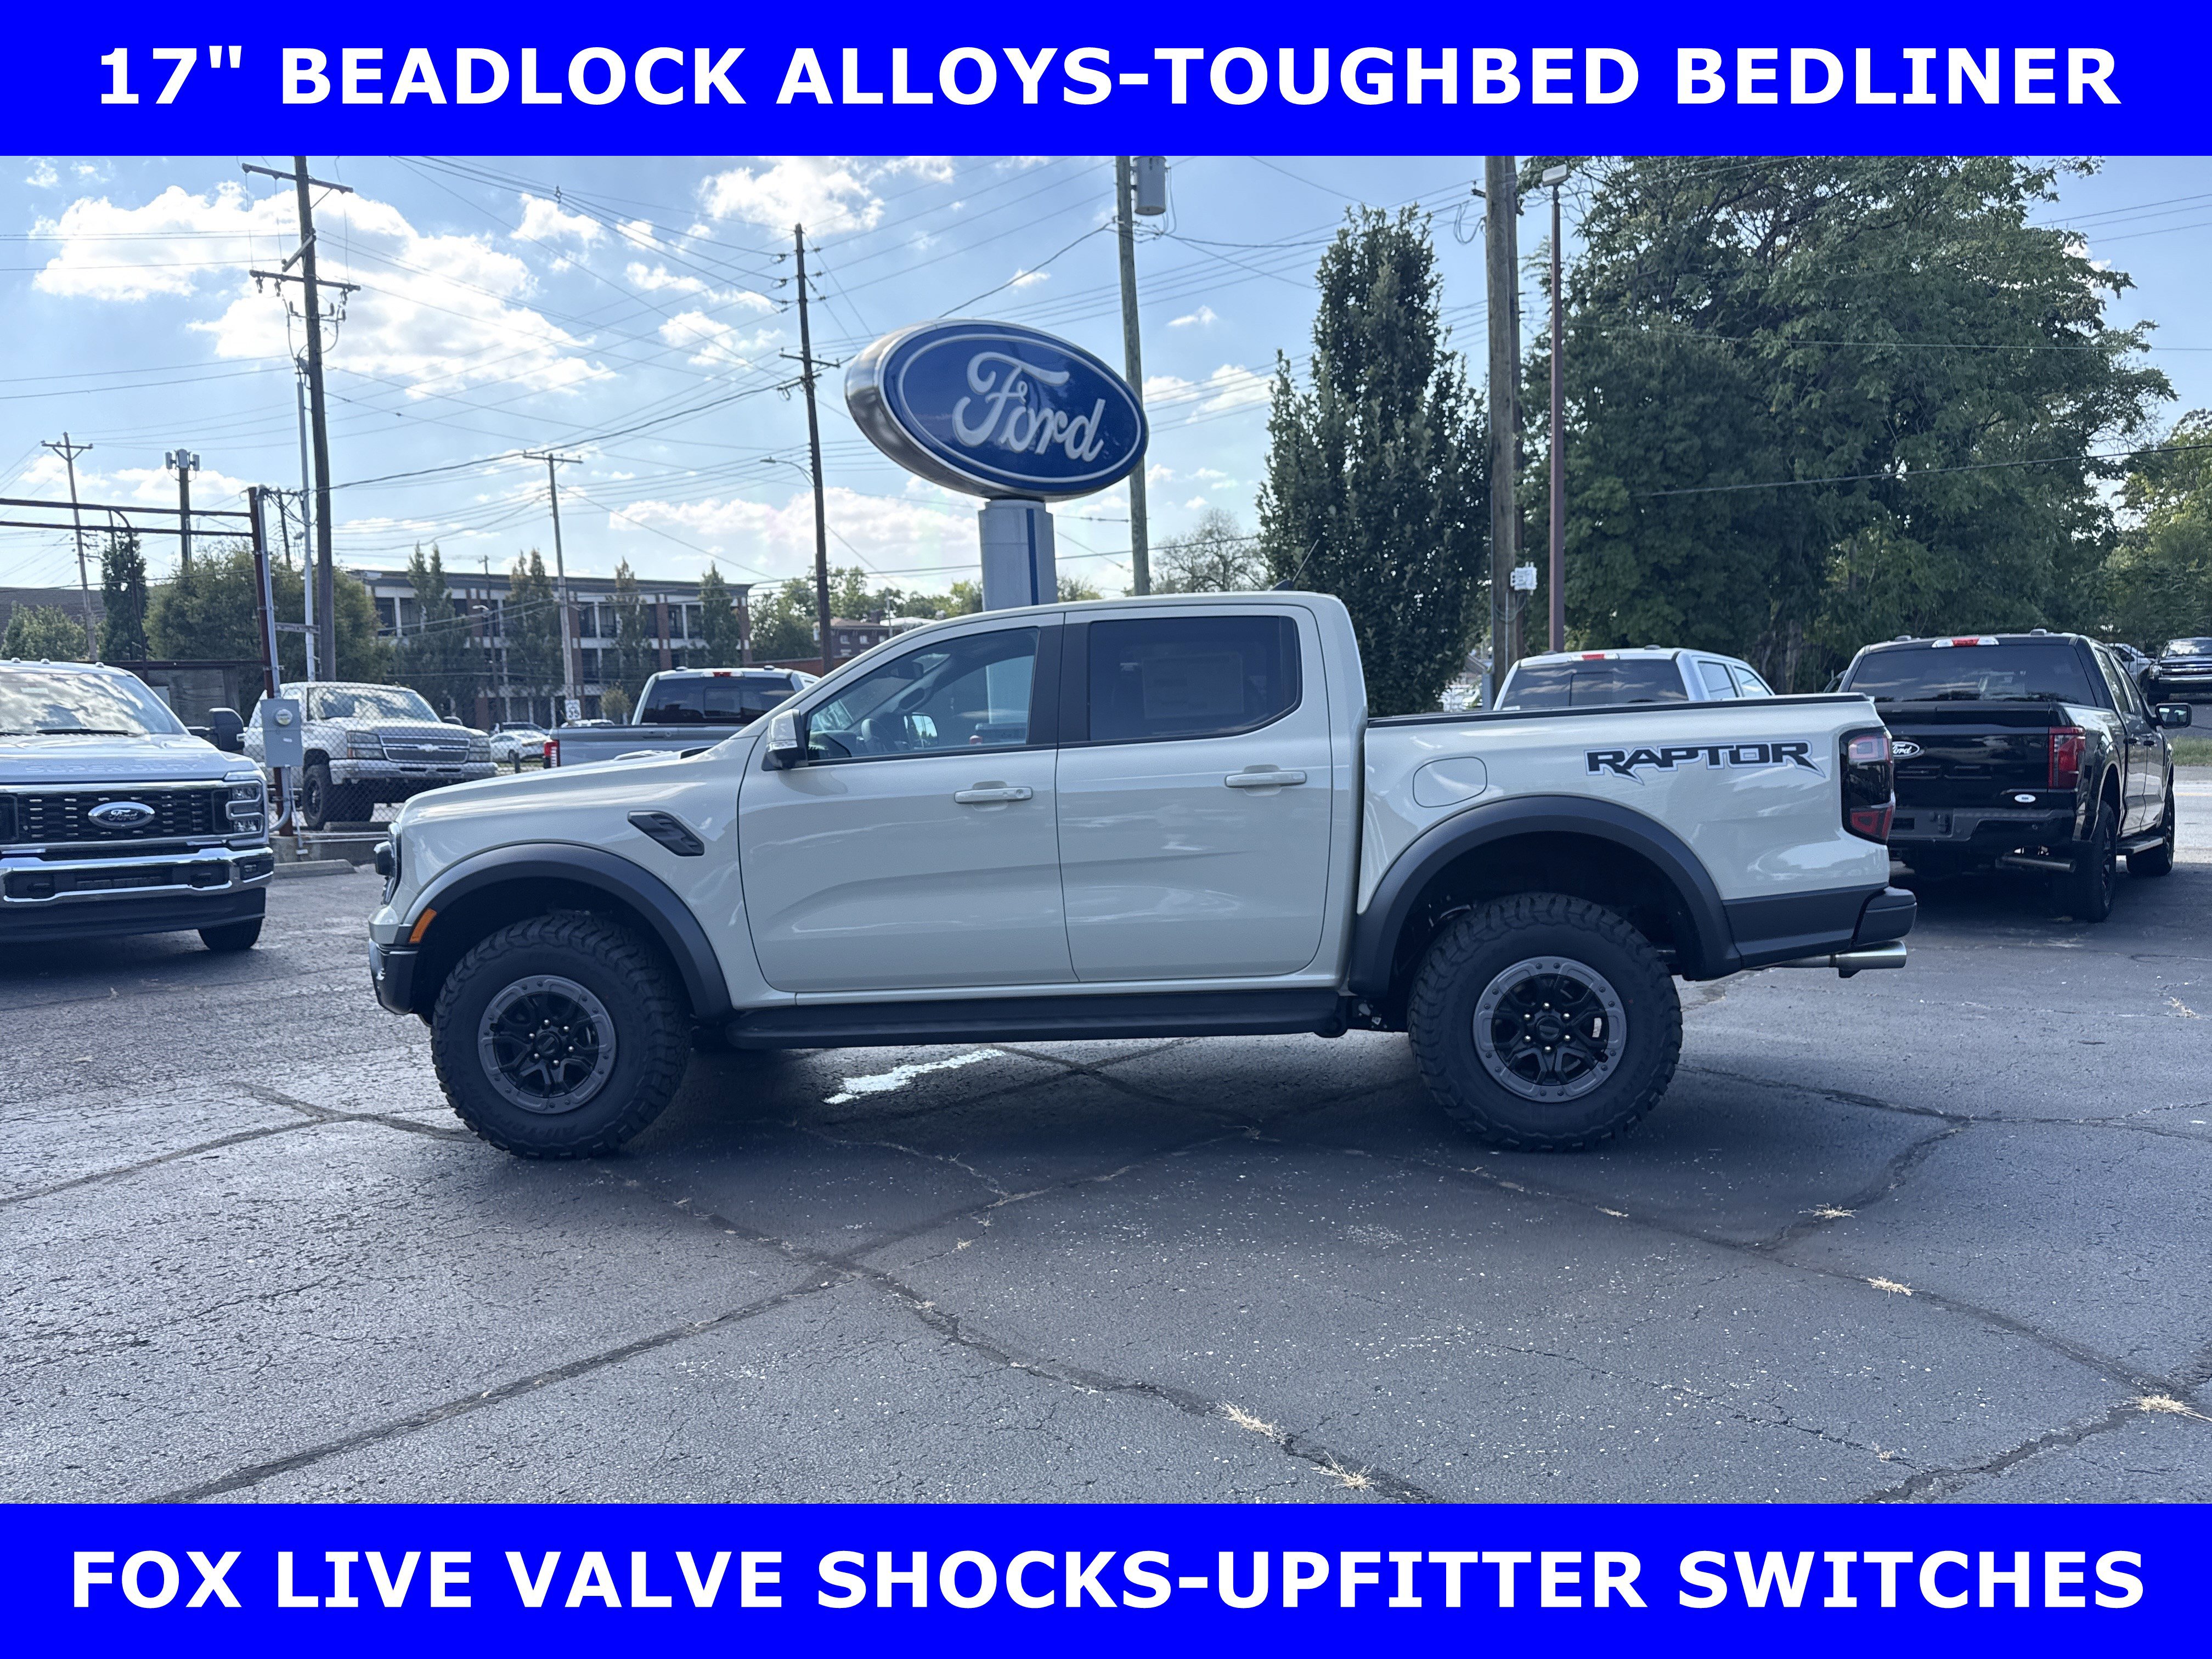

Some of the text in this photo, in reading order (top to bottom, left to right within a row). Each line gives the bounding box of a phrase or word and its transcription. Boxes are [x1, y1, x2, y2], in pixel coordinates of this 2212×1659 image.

[952, 352, 1105, 462] Ford
[1585, 741, 1826, 785] RAPTOR
[108, 809, 138, 821] Ford
